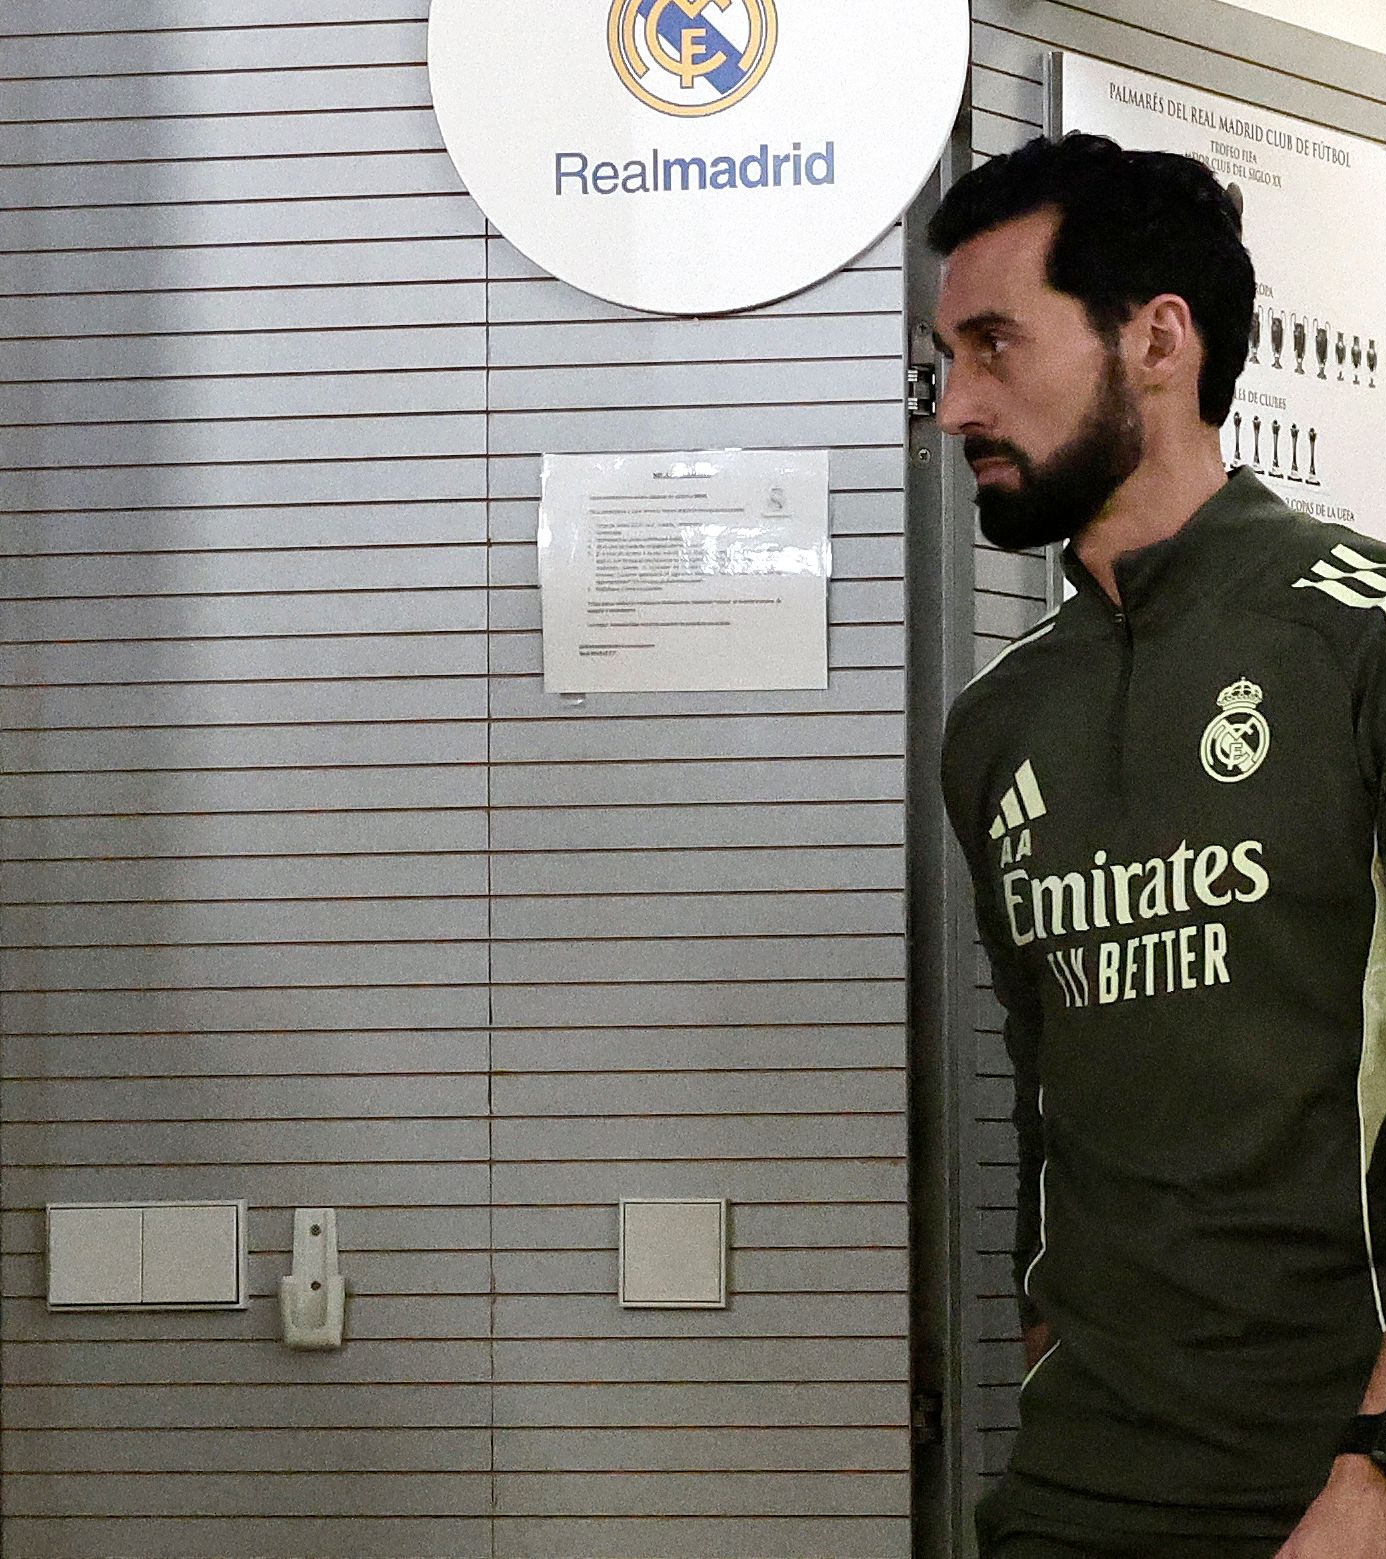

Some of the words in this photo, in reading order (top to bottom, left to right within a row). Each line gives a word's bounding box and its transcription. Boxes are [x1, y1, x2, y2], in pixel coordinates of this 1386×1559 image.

[1109, 82, 1164, 113] PALMARÉS
[1167, 99, 1188, 121] DEL
[1191, 106, 1216, 128] REAL
[1219, 115, 1263, 142] MADRID
[1266, 128, 1292, 151] CLUB
[1296, 136, 1309, 156] DE
[1312, 140, 1351, 168] FÚTBOL
[554, 141, 835, 195] Realmadrid
[1210, 140, 1240, 160] TROFEO
[1242, 149, 1257, 164] FIFA
[1211, 158, 1231, 174] CLUB
[1233, 163, 1247, 179] DEL
[1249, 167, 1271, 184] SIGLO
[1272, 175, 1282, 188] XX
[1248, 390, 1258, 404] DE
[1260, 393, 1286, 410] CLUBES
[1316, 503, 1326, 517] DE
[1327, 506, 1336, 519] LA
[1003, 839, 1270, 947] Emirates
[1099, 922, 1231, 1005] BETTER
